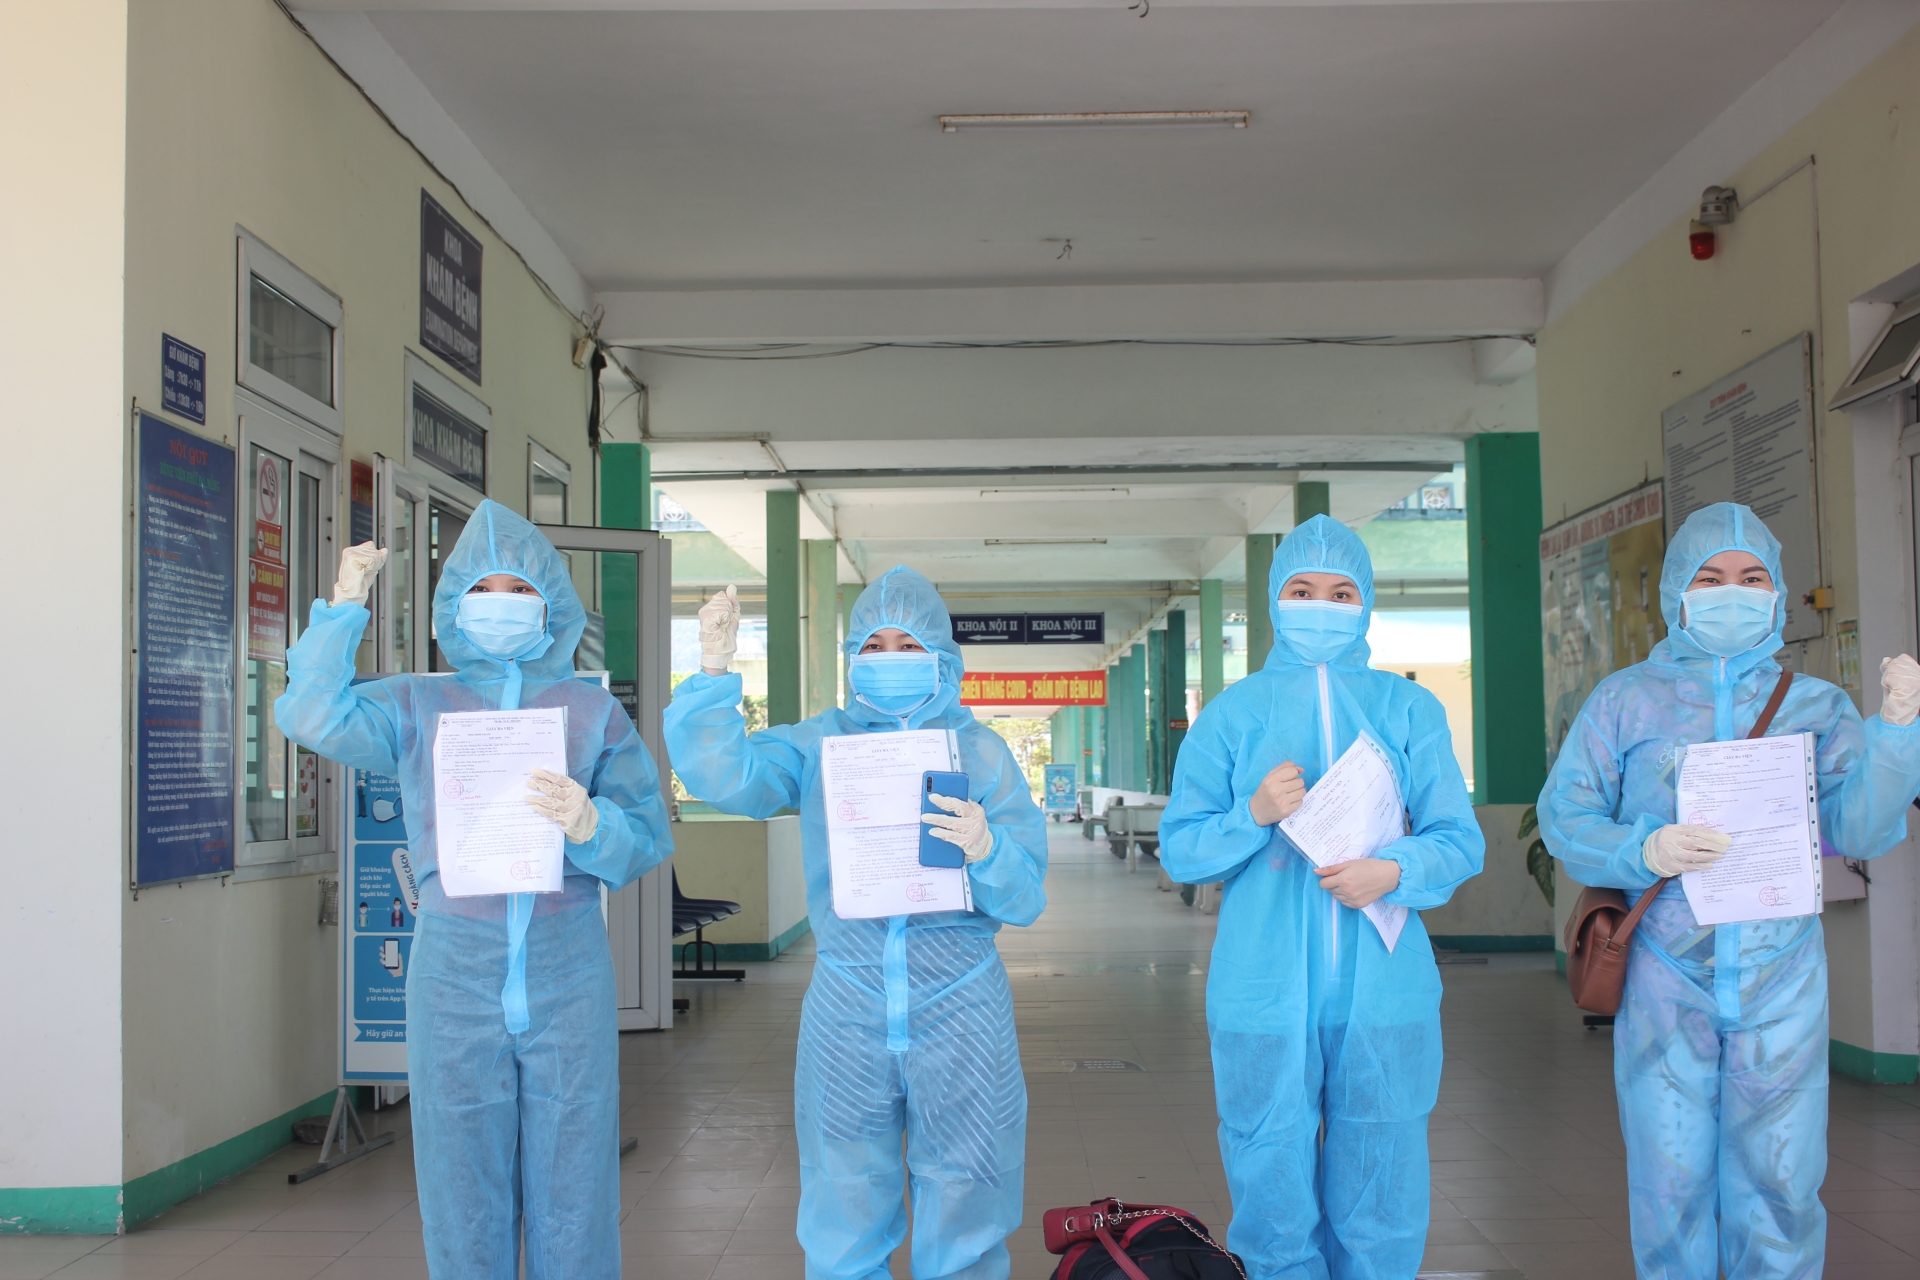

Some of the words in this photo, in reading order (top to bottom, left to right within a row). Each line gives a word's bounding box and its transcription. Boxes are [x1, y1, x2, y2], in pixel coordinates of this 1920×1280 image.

[444, 228, 462, 266] KHOA
[426, 252, 453, 311] KHÁM
[455, 275, 477, 331] BỆNH
[169, 439, 187, 460] NỘI
[189, 447, 209, 466] QUY
[436, 421, 460, 467] KHÁM
[462, 433, 483, 480] BỆNH
[258, 566, 273, 586] CẢNH
[273, 571, 284, 589] BÁO
[957, 621, 987, 631] KHOA
[988, 619, 1007, 633] NỘI
[1010, 620, 1018, 631] II
[1032, 620, 1061, 631] KHOA
[1063, 618, 1081, 632] NỘI
[1084, 620, 1096, 630] III
[960, 674, 981, 699] CHIẾN
[982, 673, 1005, 699] THẮNG
[1006, 680, 1027, 699] COVID
[1032, 674, 1053, 699] CHẤM
[1055, 676, 1068, 699] DỨT
[1069, 676, 1088, 703] BỆNH
[1089, 680, 1103, 699] LAO
[366, 1029, 380, 1039] Hãy
[381, 1029, 393, 1039] giữ
